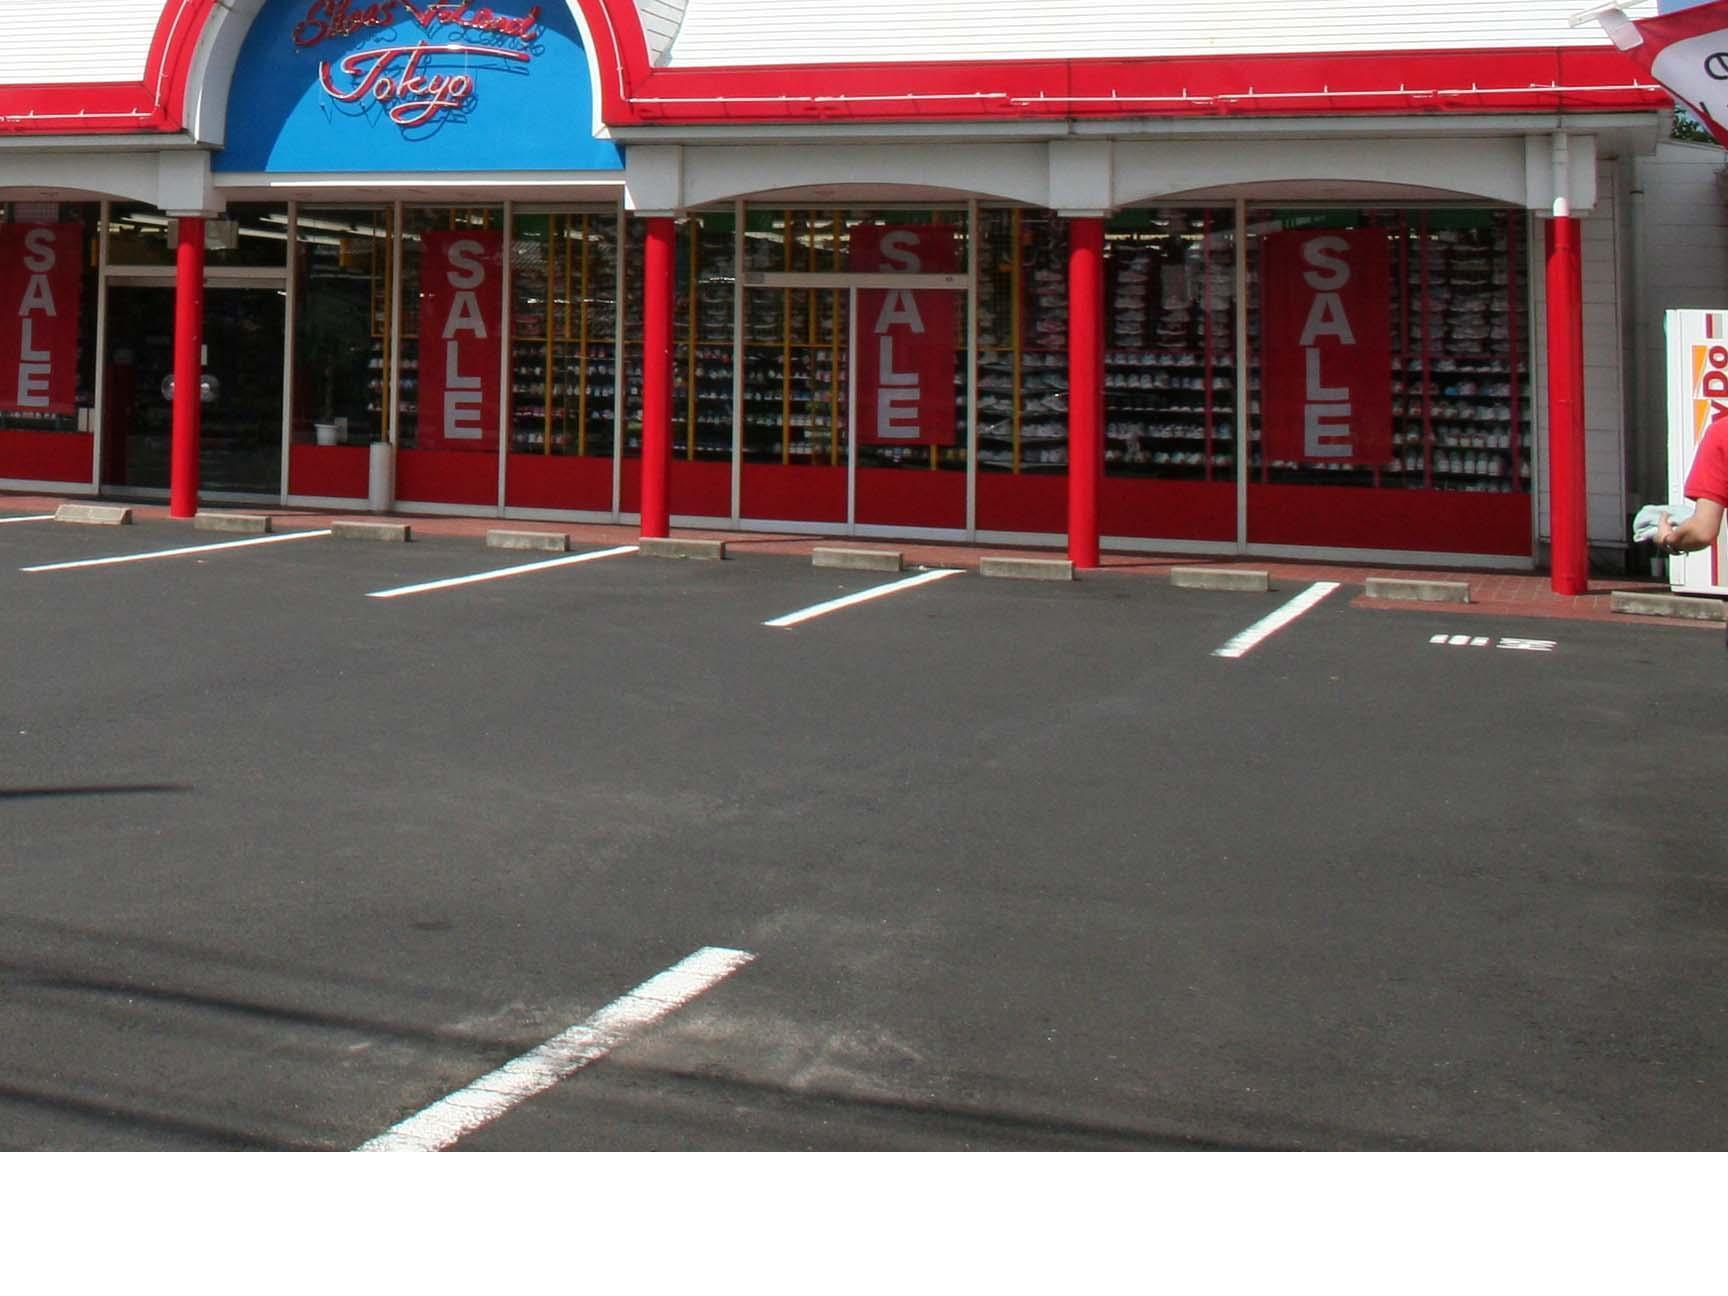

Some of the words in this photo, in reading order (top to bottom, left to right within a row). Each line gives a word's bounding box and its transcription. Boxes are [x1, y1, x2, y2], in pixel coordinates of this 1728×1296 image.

[319, 40, 531, 127] Tokyo
[16, 227, 57, 408] SALE
[441, 239, 488, 440] SALE
[874, 230, 925, 439] SALE
[1299, 235, 1357, 458] SALE
